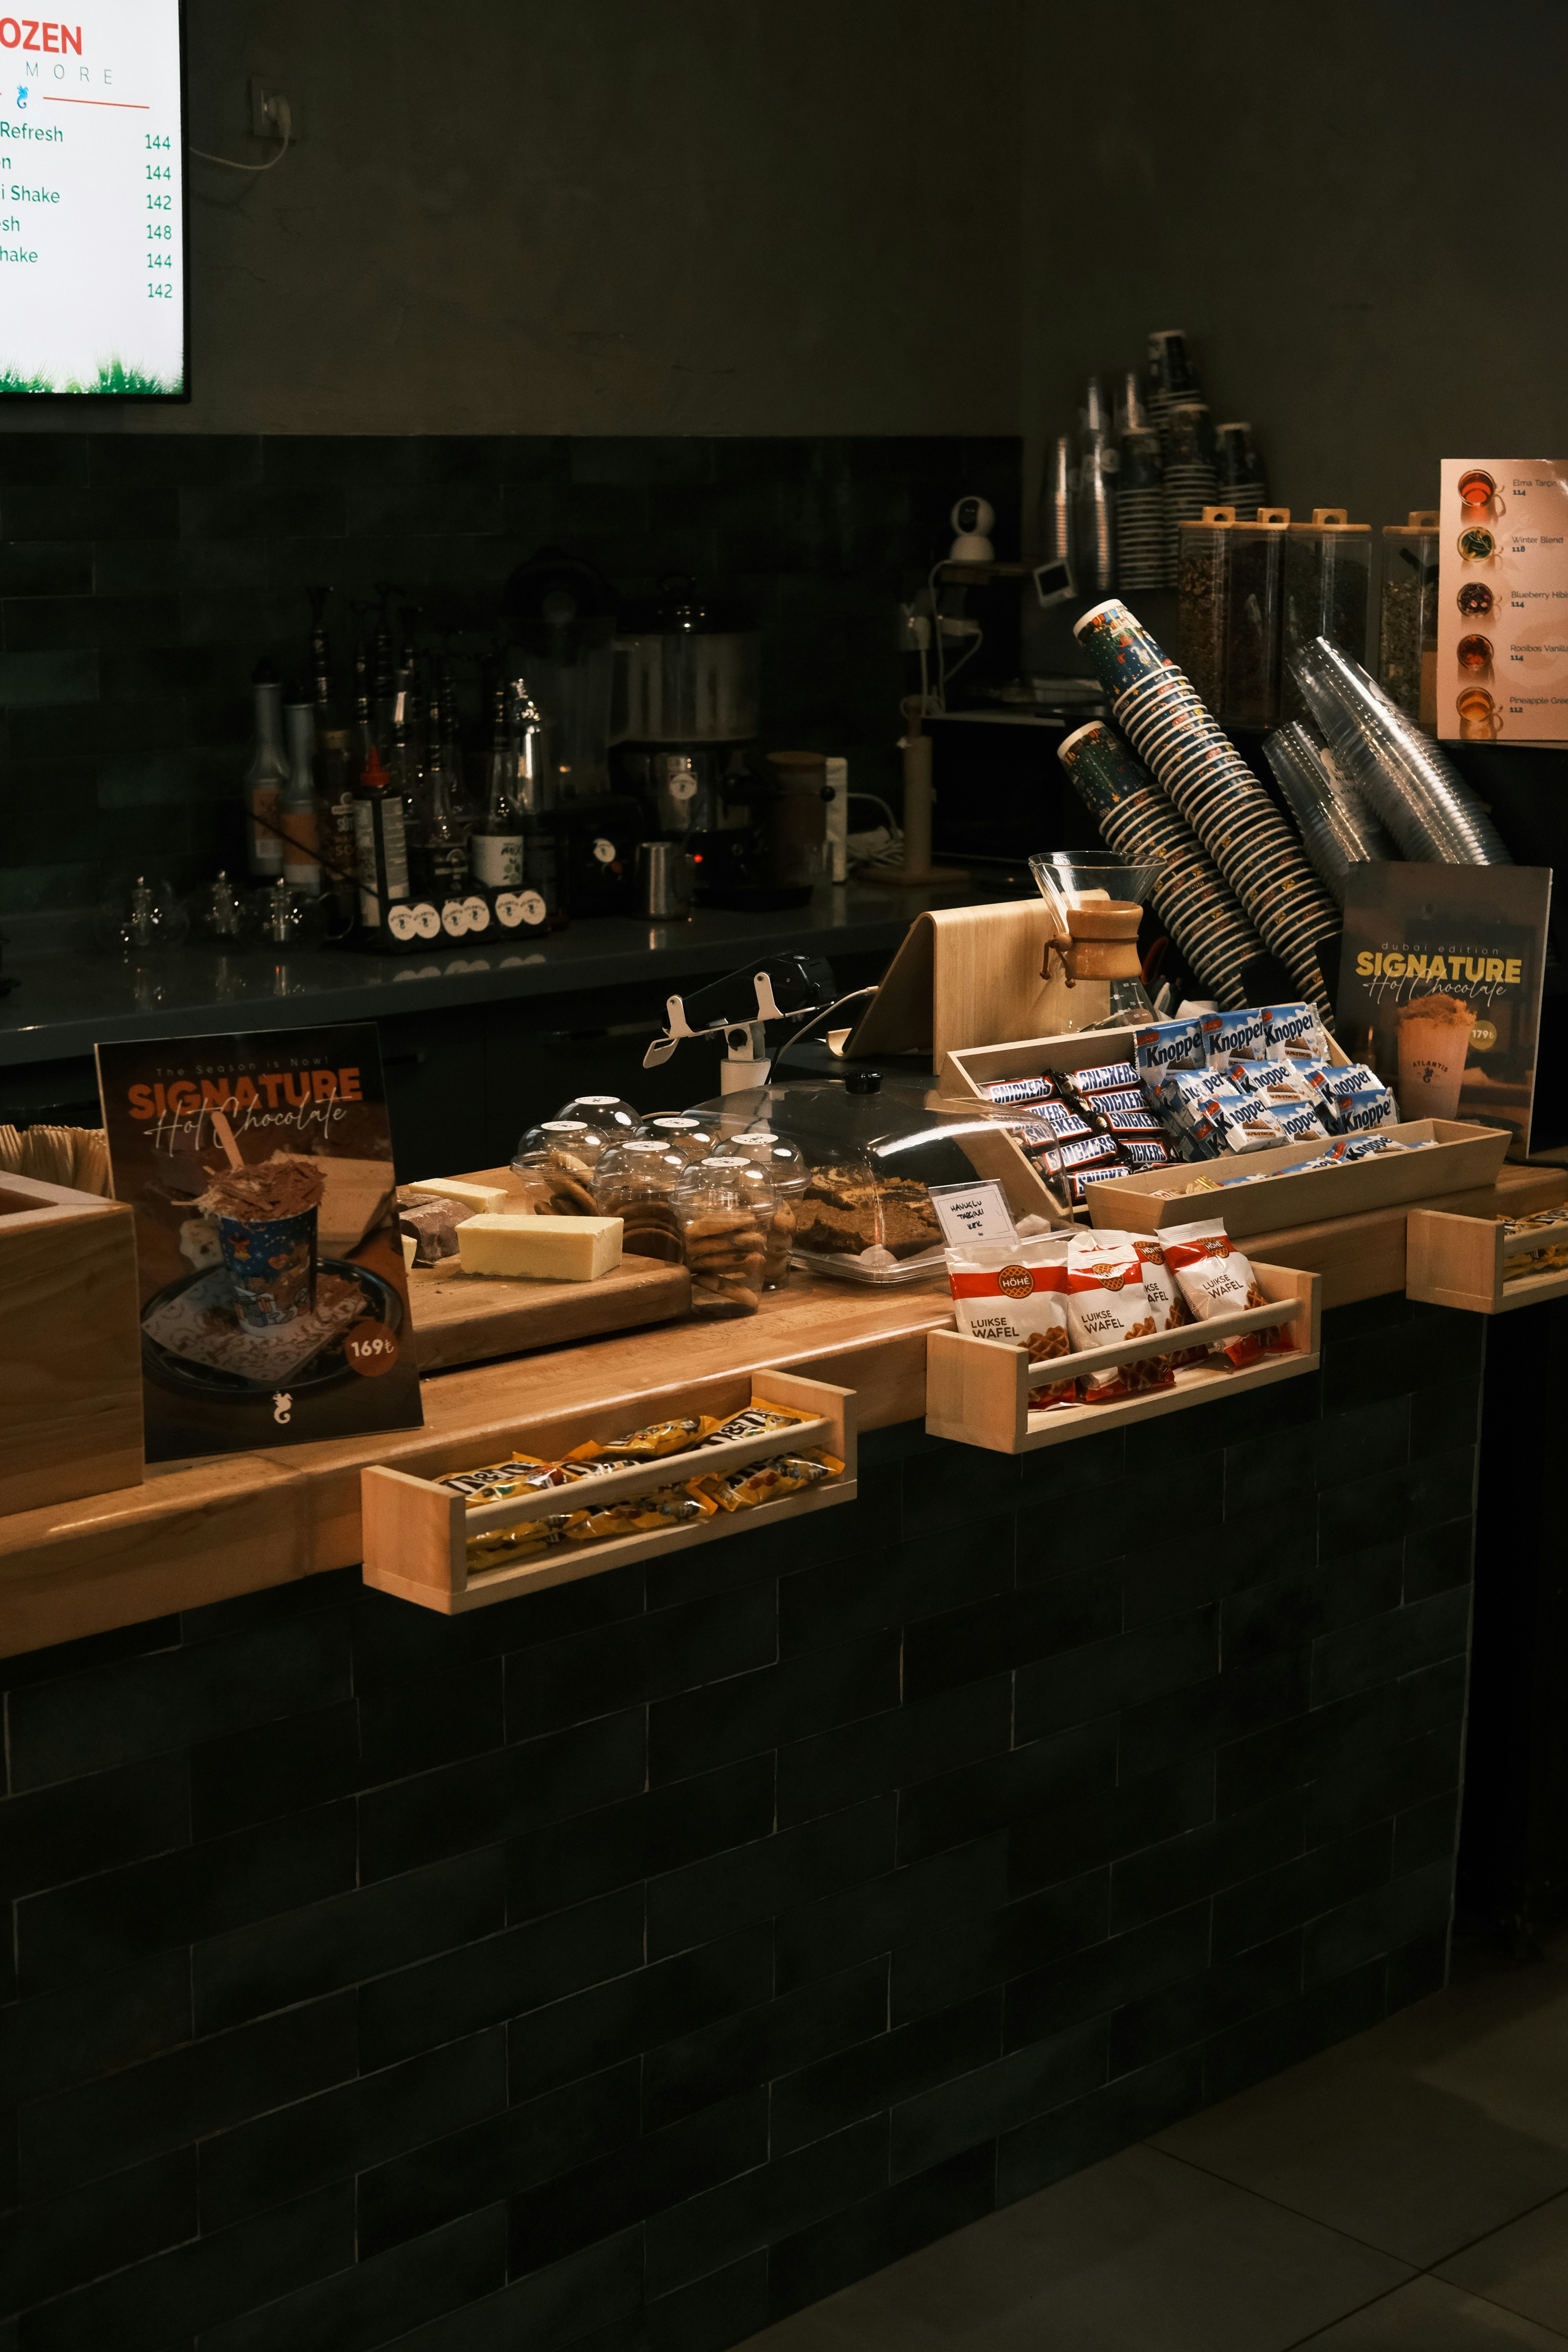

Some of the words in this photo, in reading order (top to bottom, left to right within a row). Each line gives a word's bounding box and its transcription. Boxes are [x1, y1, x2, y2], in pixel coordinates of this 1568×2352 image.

[26, 61, 112, 85] MORE
[0, 121, 63, 142] Refresh
[145, 134, 171, 150] 144
[145, 164, 172, 181] 144
[11, 185, 60, 203] Shake
[146, 194, 172, 210] 142
[0, 215, 20, 231] sh
[146, 224, 172, 240] 148
[147, 253, 172, 269] 144
[147, 283, 173, 298] 142
[1511, 591, 1550, 600] Blueberry
[1510, 697, 1549, 705] Pineapple
[1381, 942, 1428, 952] dubai
[1438, 945, 1499, 956] edition
[1355, 951, 1522, 984] SIGNATURE
[1362, 966, 1421, 1004] Hot
[1409, 967, 1516, 1007] Chocolate
[1263, 1014, 1314, 1047] Knopper
[156, 1067, 185, 1077] The
[195, 1062, 257, 1075] Season
[266, 1060, 280, 1069] is
[289, 1055, 329, 1067] Now!
[1413, 1060, 1448, 1072] ATLANTIS
[1079, 1064, 1139, 1091] SNICKERS
[127, 1067, 364, 1120] SIGNATURE
[992, 1078, 1051, 1104] SNICKERS
[143, 1097, 222, 1158] Hot
[213, 1086, 353, 1148] Chocolate
[1047, 1135, 1116, 1169] SNICKERS
[967, 1220, 983, 1230] KEK
[1205, 1240, 1223, 1250] HÖHÉ
[1002, 1276, 1030, 1287] HÖHÉ
[1202, 1274, 1230, 1291] LUIKSE
[1208, 1280, 1244, 1298] WAFEL
[1147, 1291, 1169, 1303] AFEL
[971, 1317, 1007, 1328] LUIKSE
[1081, 1310, 1112, 1323] LUIKSE
[972, 1326, 1020, 1338] WAFEL
[1084, 1318, 1125, 1334] WAFEL
